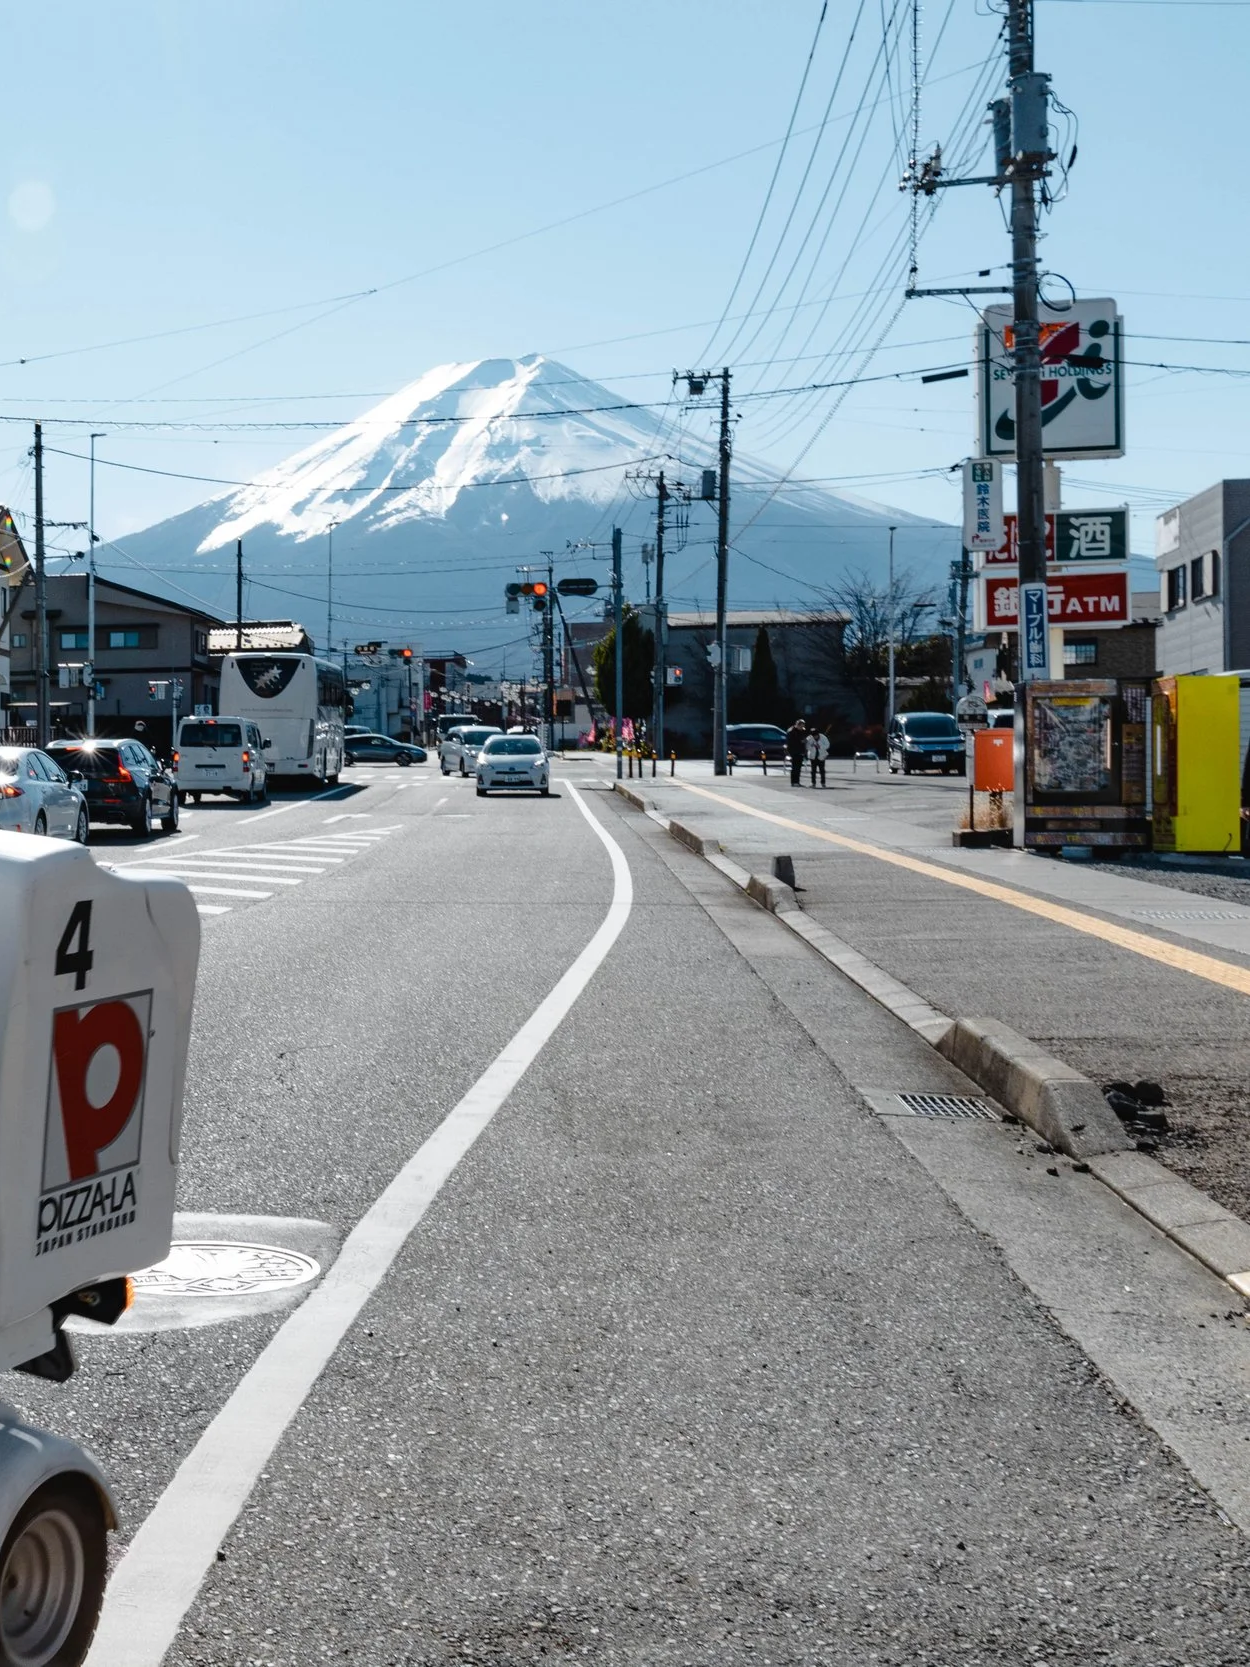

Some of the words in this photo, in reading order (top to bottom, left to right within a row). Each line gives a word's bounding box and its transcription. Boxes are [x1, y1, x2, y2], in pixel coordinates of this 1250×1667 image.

[976, 482, 991, 532] 鈴木医院
[1069, 516, 1112, 558] 酒
[55, 900, 94, 990] 4
[35, 1232, 73, 1257] JAPAN
[77, 1210, 136, 1242] STANDARD
